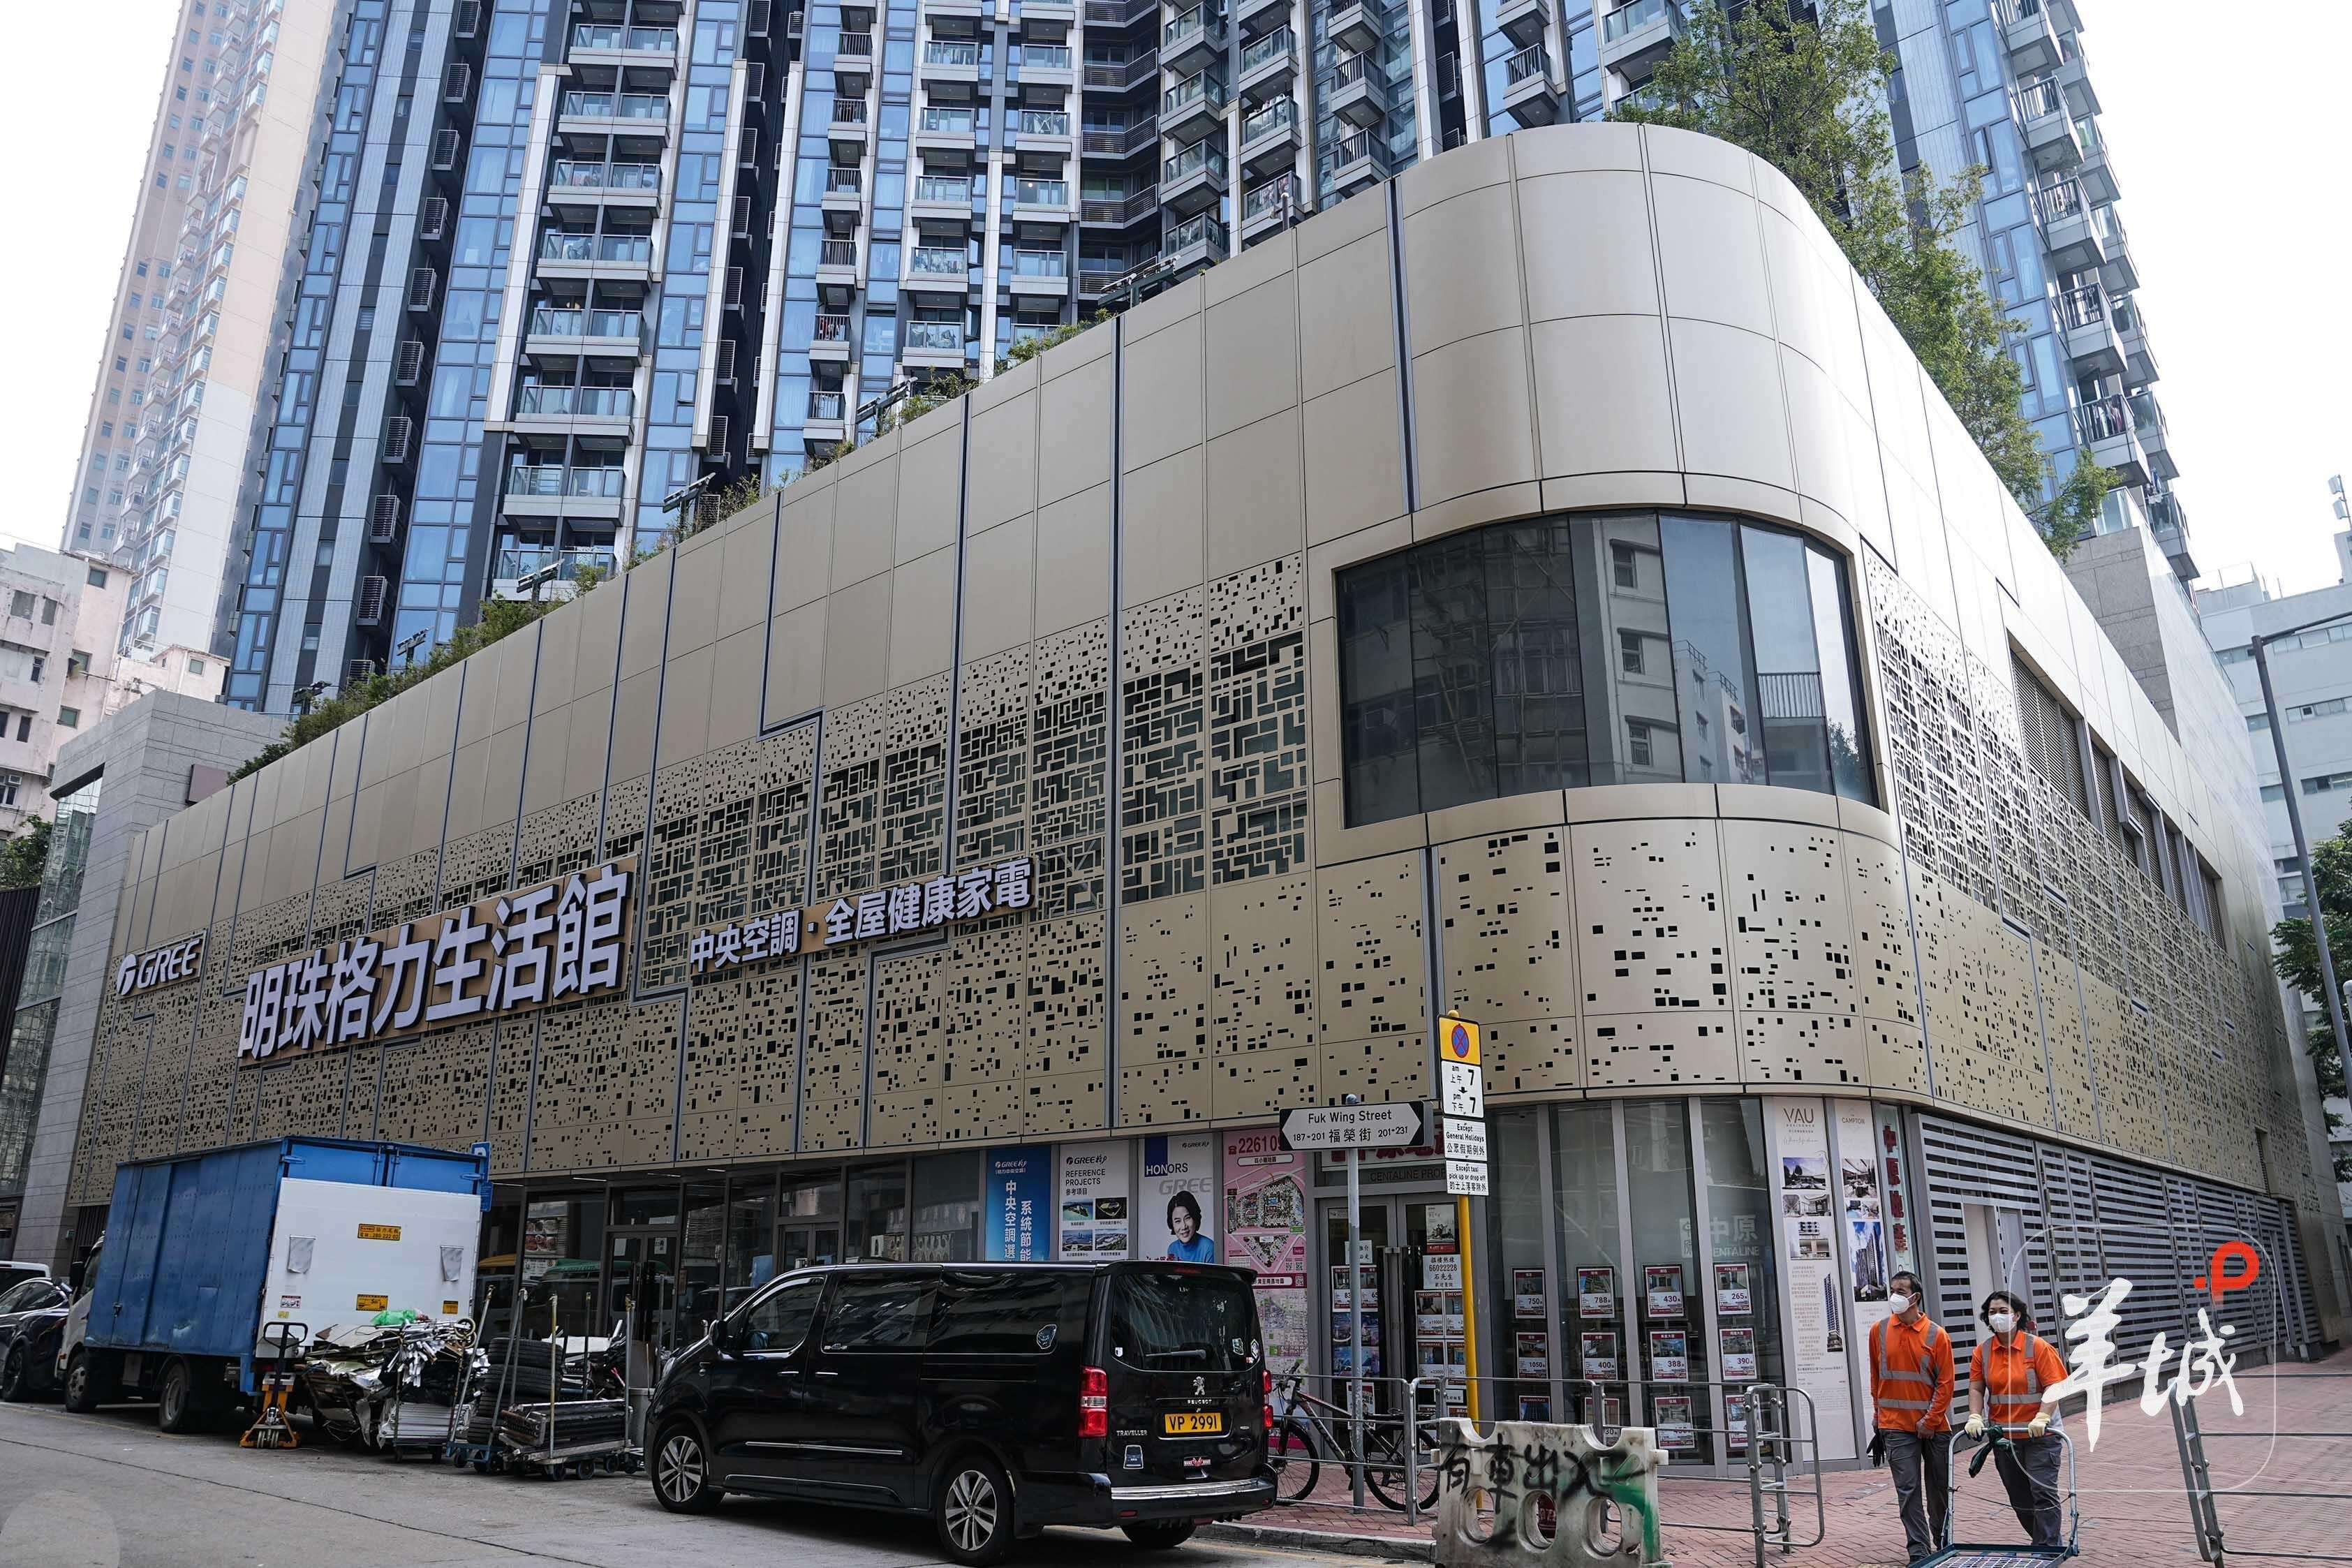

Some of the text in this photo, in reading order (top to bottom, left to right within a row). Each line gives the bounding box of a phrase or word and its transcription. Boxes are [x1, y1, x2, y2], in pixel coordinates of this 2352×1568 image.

[136, 937, 202, 989] GREE
[237, 864, 632, 1059] 明珠格力生活館
[1450, 1074, 1463, 1084] 上午
[1467, 1069, 1474, 1086] 7
[1451, 1102, 1464, 1112] 下午
[1470, 1097, 1476, 1114] 7
[1308, 1109, 1392, 1124] Fuk Wing Street
[1783, 1108, 1814, 1124] VAU
[1378, 1125, 1408, 1138] 201-231
[1457, 1123, 1473, 1132] Except
[1293, 1132, 1325, 1141] 187-201
[1329, 1127, 1371, 1143] 福榮街
[1446, 1132, 1484, 1143] General Holidays
[1065, 1169, 1106, 1178] REFERENCE
[1146, 1162, 1188, 1176] HONORS
[1456, 1164, 1470, 1172] Except
[1065, 1178, 1101, 1186] PROJECTS
[1159, 1177, 1213, 1195] GREE
[1005, 1180, 1016, 1261] 中央空調選
[1713, 1246, 1760, 1257] ENTALINE
[1169, 1416, 1218, 1430] VP 2991
